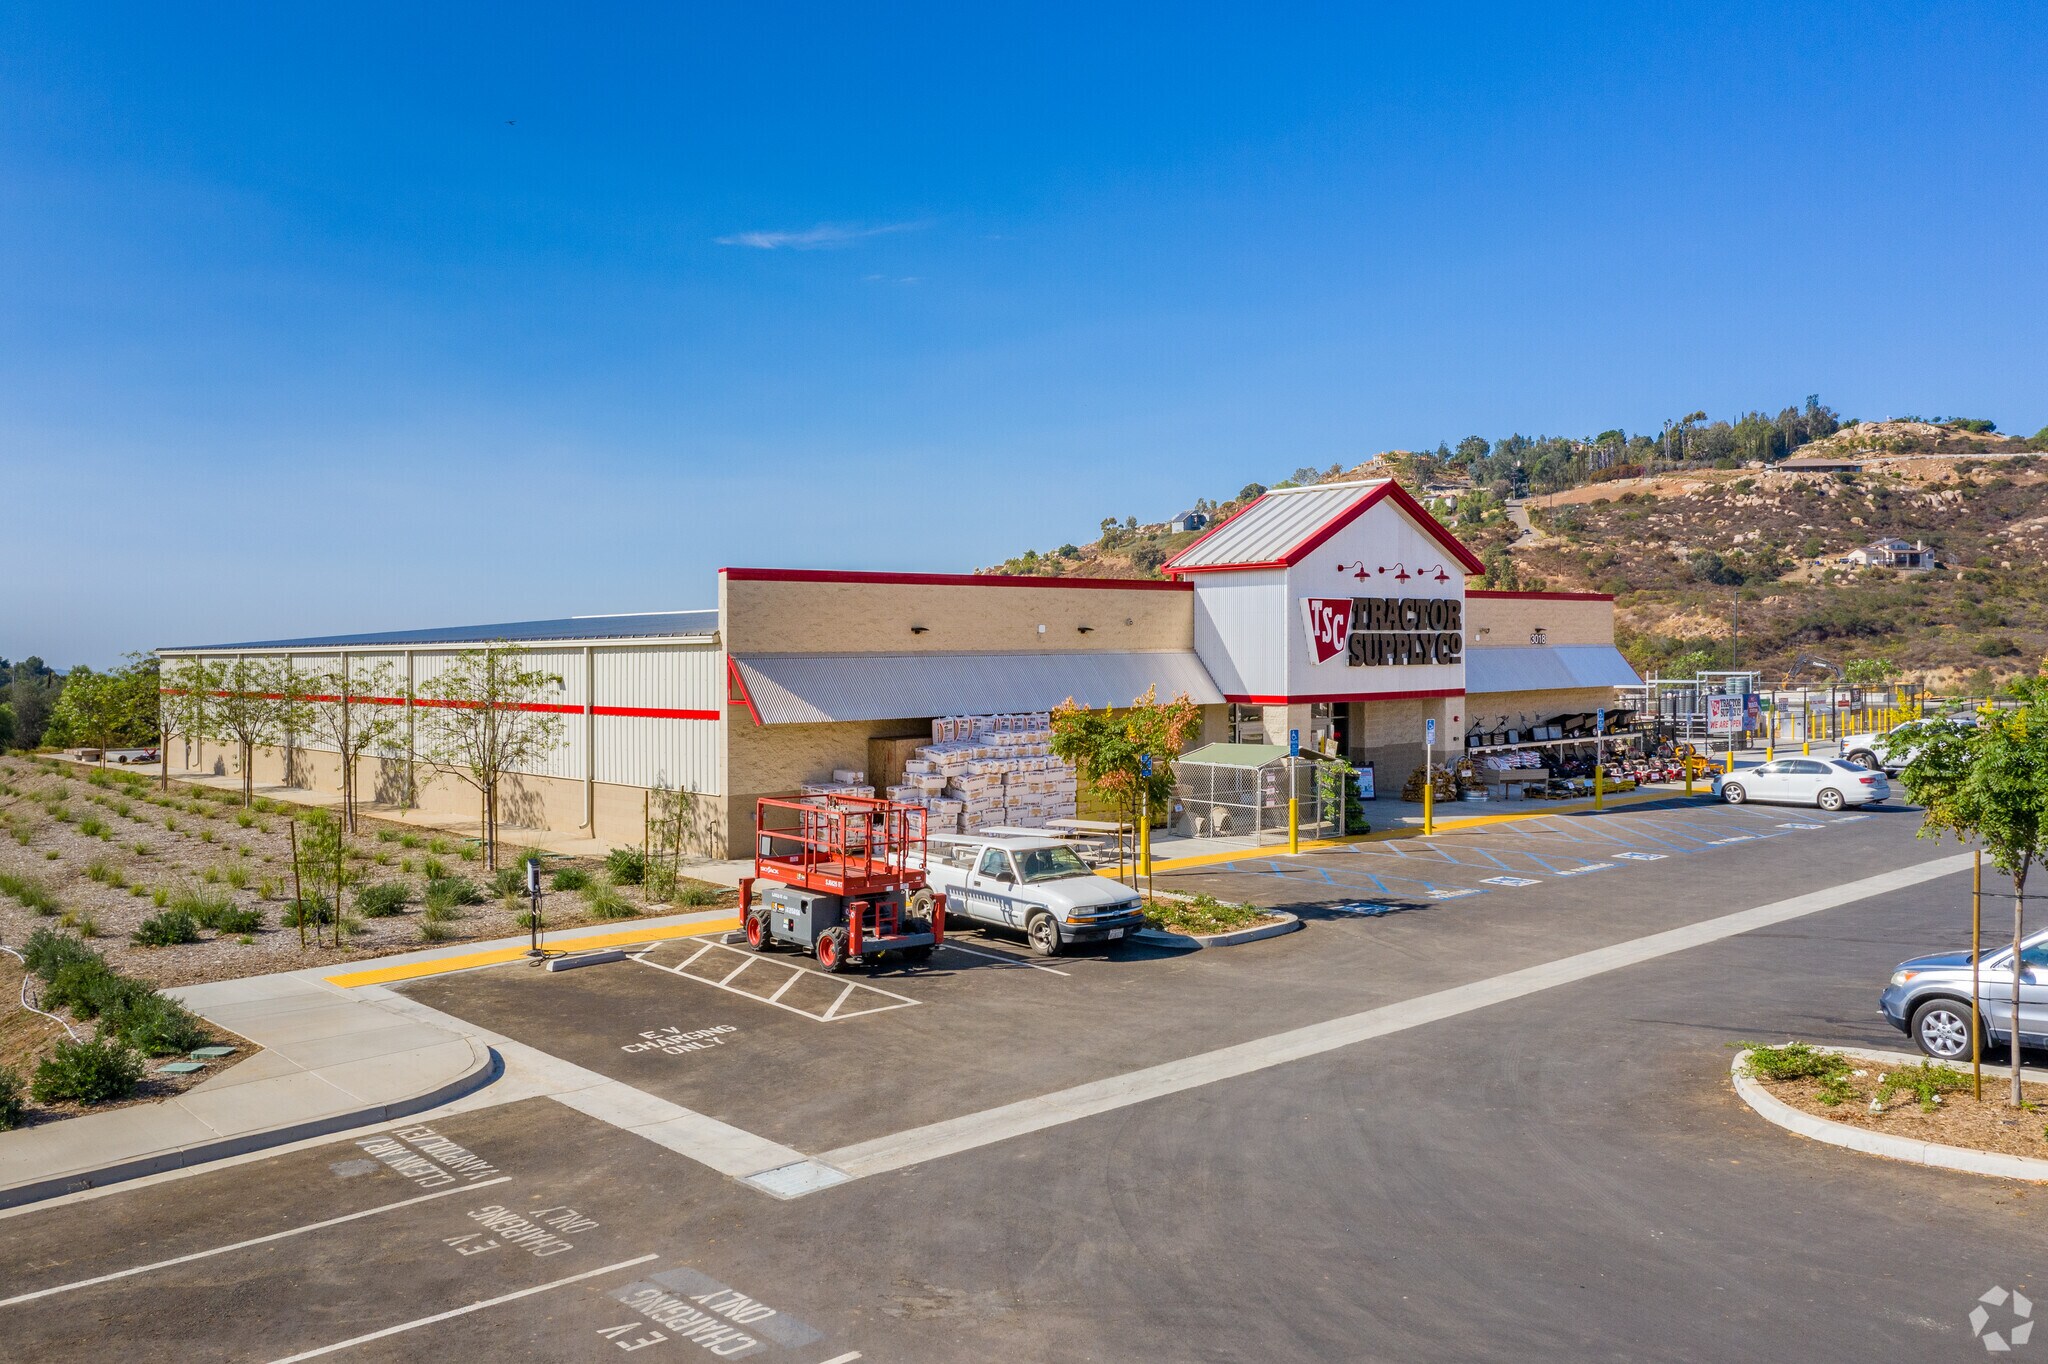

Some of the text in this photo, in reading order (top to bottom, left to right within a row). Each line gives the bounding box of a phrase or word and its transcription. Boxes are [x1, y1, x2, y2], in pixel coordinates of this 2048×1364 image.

[1312, 600, 1344, 651] TSC
[1352, 598, 1462, 631] TRACTOR
[1349, 633, 1435, 667] SUPPLY
[1720, 698, 1742, 708] TRACTOR
[1710, 721, 1719, 729] WE
[1719, 720, 1729, 728] ARE
[621, 1024, 738, 1053] CHARGING
[662, 1036, 725, 1055] ONLY
[391, 1154, 456, 1188] CLEAN
[467, 1205, 574, 1257] CHARGING
[529, 1205, 600, 1234] ONLY
[442, 1232, 501, 1256] EV
[620, 1288, 757, 1355] CHARGING
[689, 1288, 777, 1324] ONLY
[596, 1321, 669, 1352] EV
